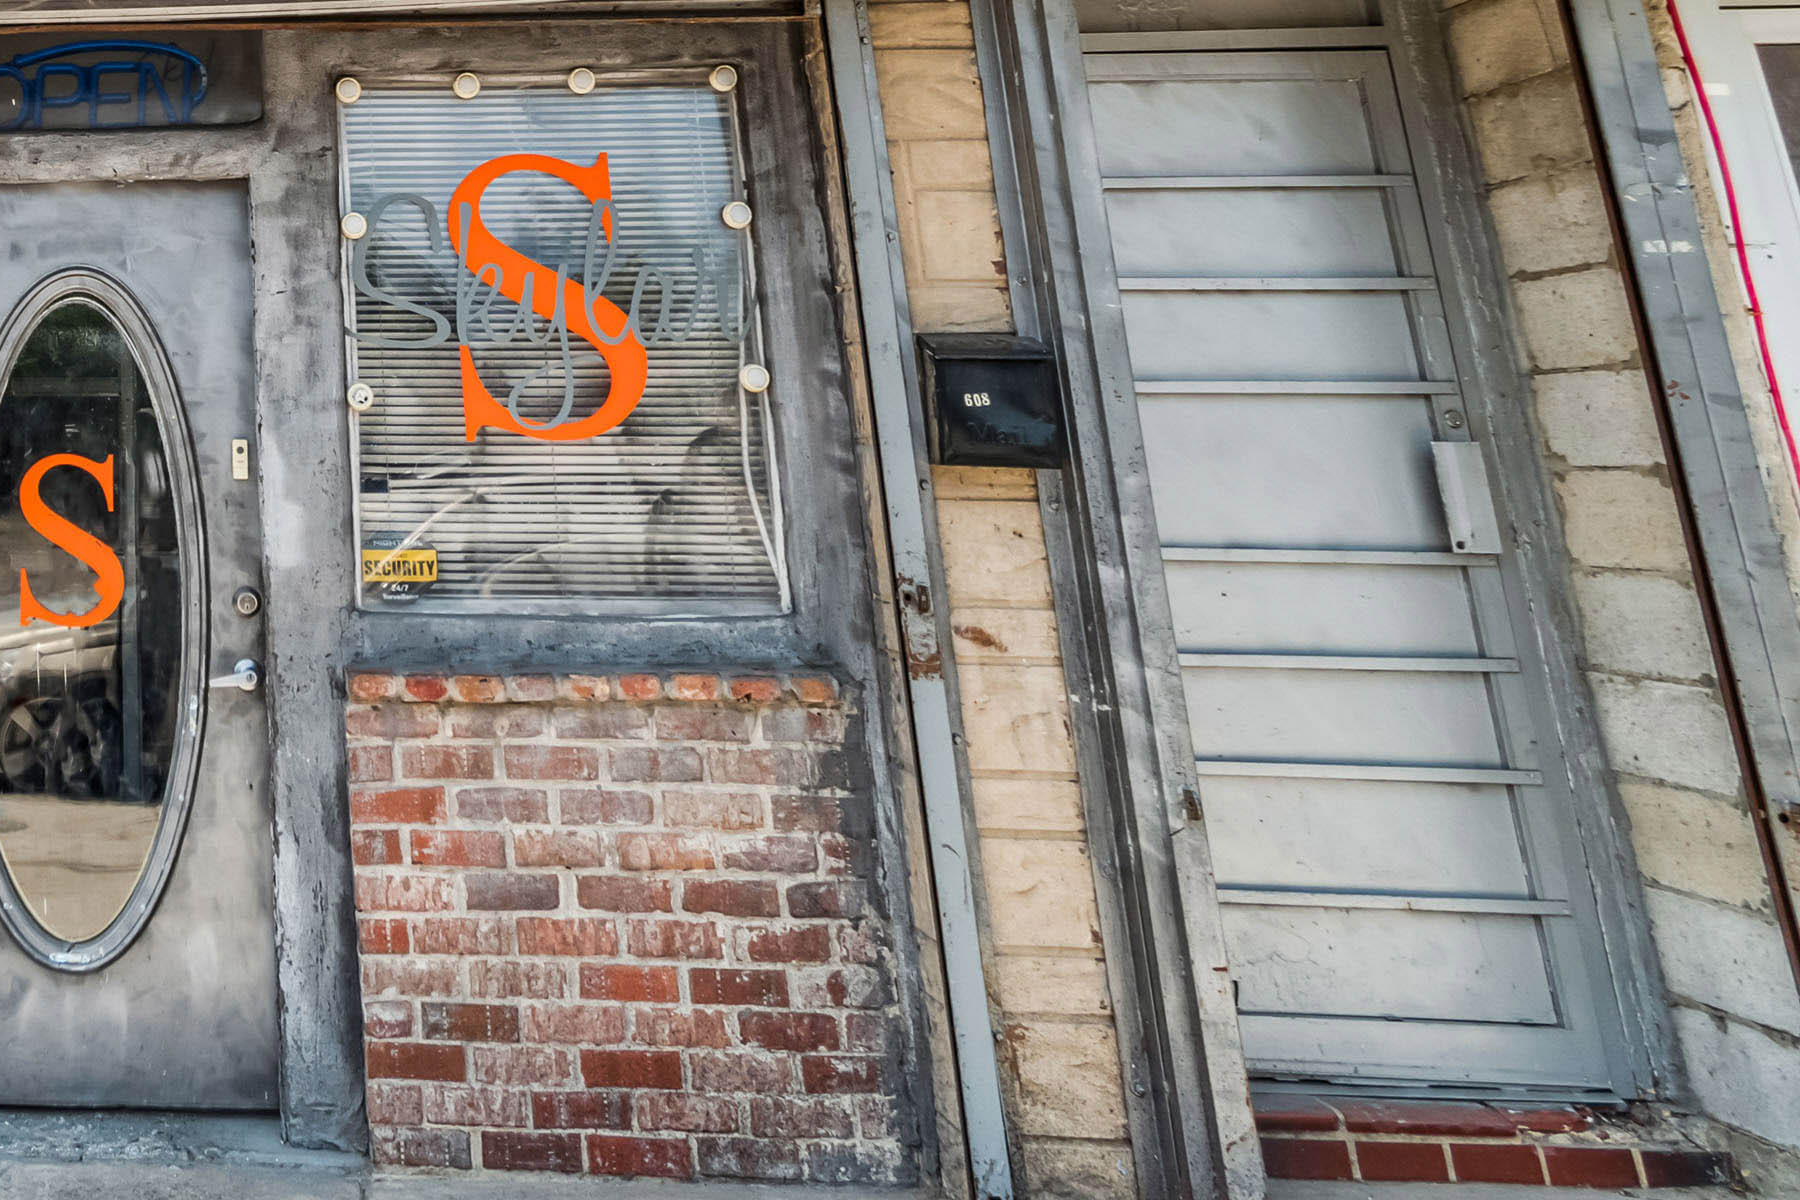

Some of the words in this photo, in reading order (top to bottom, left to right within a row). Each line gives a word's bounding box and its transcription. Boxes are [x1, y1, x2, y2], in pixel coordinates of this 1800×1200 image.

[345, 192, 757, 430] Skylar
[448, 151, 649, 442] S
[964, 392, 991, 407] 608
[19, 452, 126, 628] S
[364, 559, 435, 577] SECURITY
